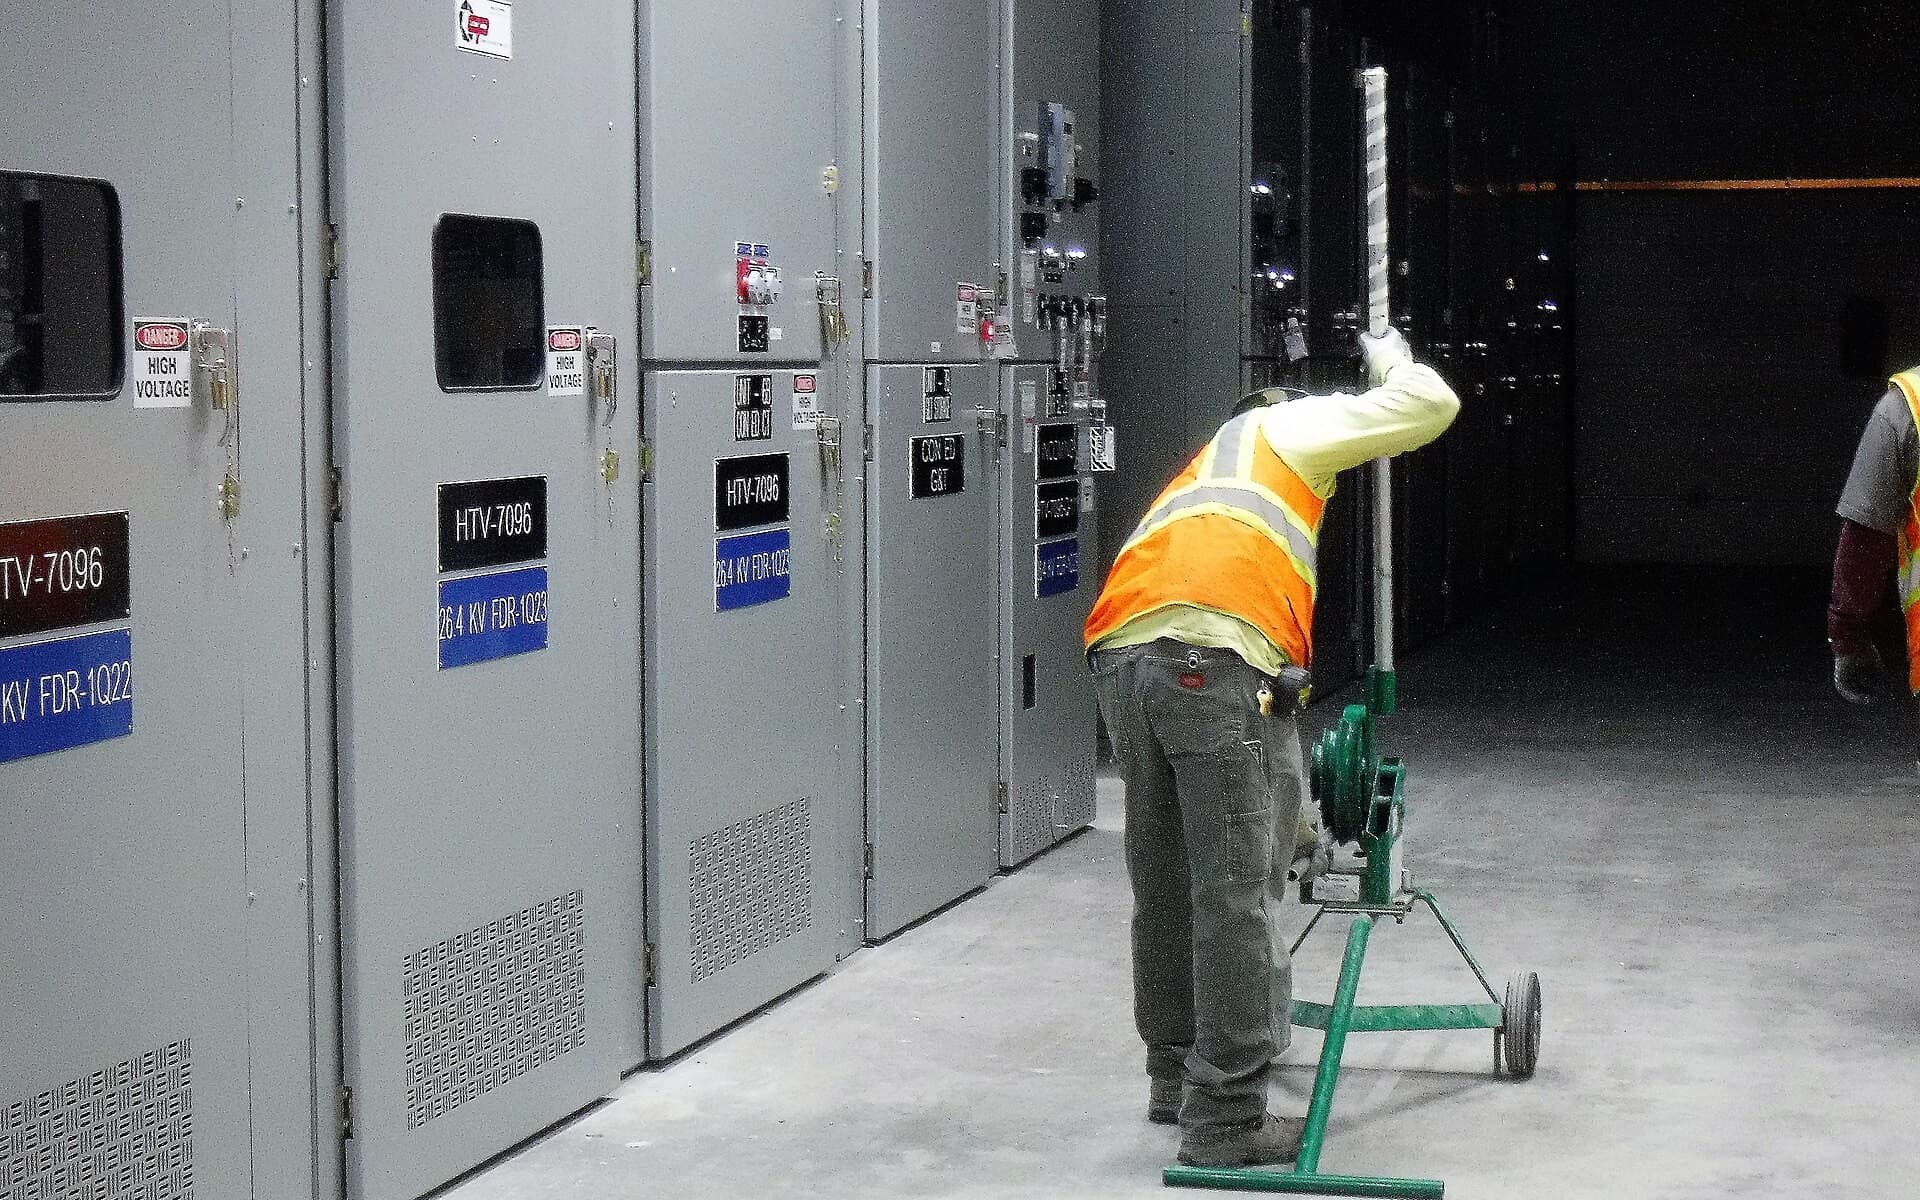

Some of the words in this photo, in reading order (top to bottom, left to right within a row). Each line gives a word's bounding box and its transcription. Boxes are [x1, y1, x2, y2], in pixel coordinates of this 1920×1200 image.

[142, 328, 181, 347] DANGER
[148, 356, 177, 375] HIGH
[556, 356, 575, 370] HIGH
[136, 379, 190, 398] VOLTAGE
[549, 373, 582, 389] VOLTAGE
[921, 439, 941, 462] CON
[727, 474, 779, 507] HTV-7096
[456, 502, 533, 542] HTV-7096
[0, 546, 103, 599] TV-7096
[737, 556, 750, 584] KV
[439, 604, 464, 640] 26.4
[469, 601, 487, 634] KV
[492, 591, 548, 630] FDR-1Q23
[2, 679, 30, 723] KV
[39, 660, 131, 716] FDR-1Q22
